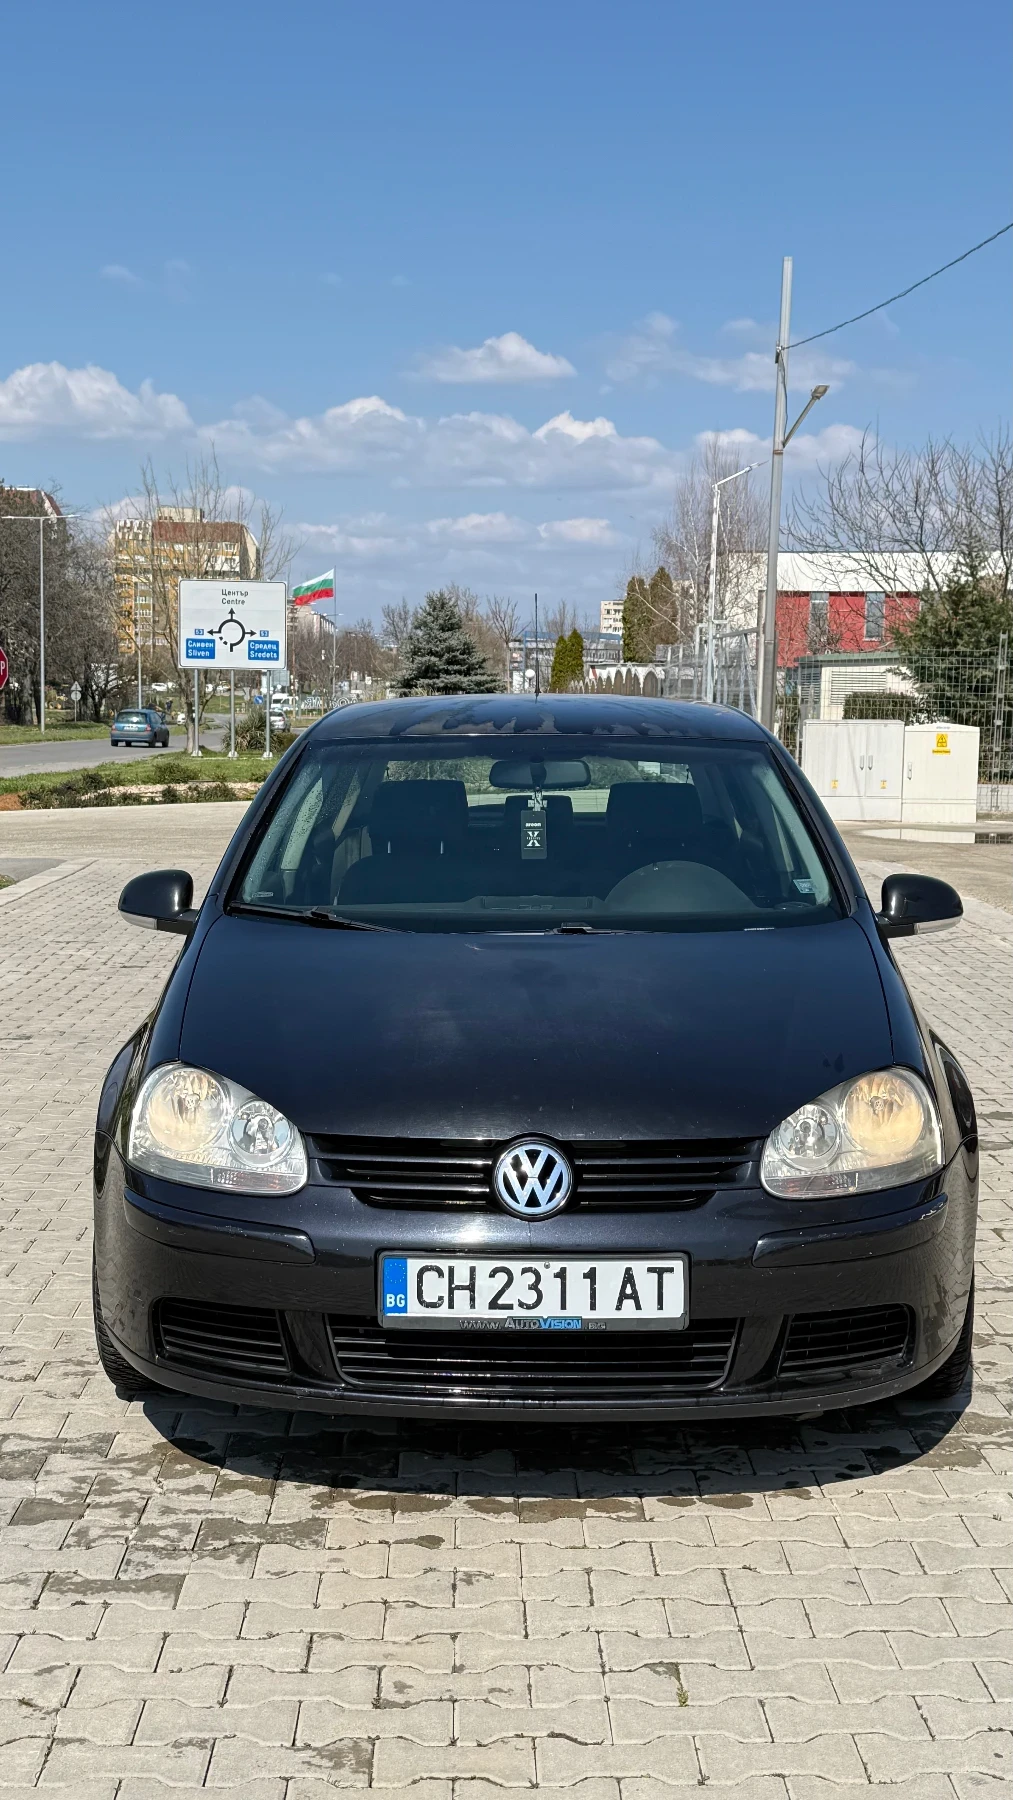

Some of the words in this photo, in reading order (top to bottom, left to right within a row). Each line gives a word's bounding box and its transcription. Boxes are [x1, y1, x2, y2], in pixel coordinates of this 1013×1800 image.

[221, 589, 249, 597] Център
[249, 642, 277, 650] Средец
[187, 649, 210, 657] Sliven
[249, 651, 278, 659] Sredets
[386, 1293, 405, 1308] BG
